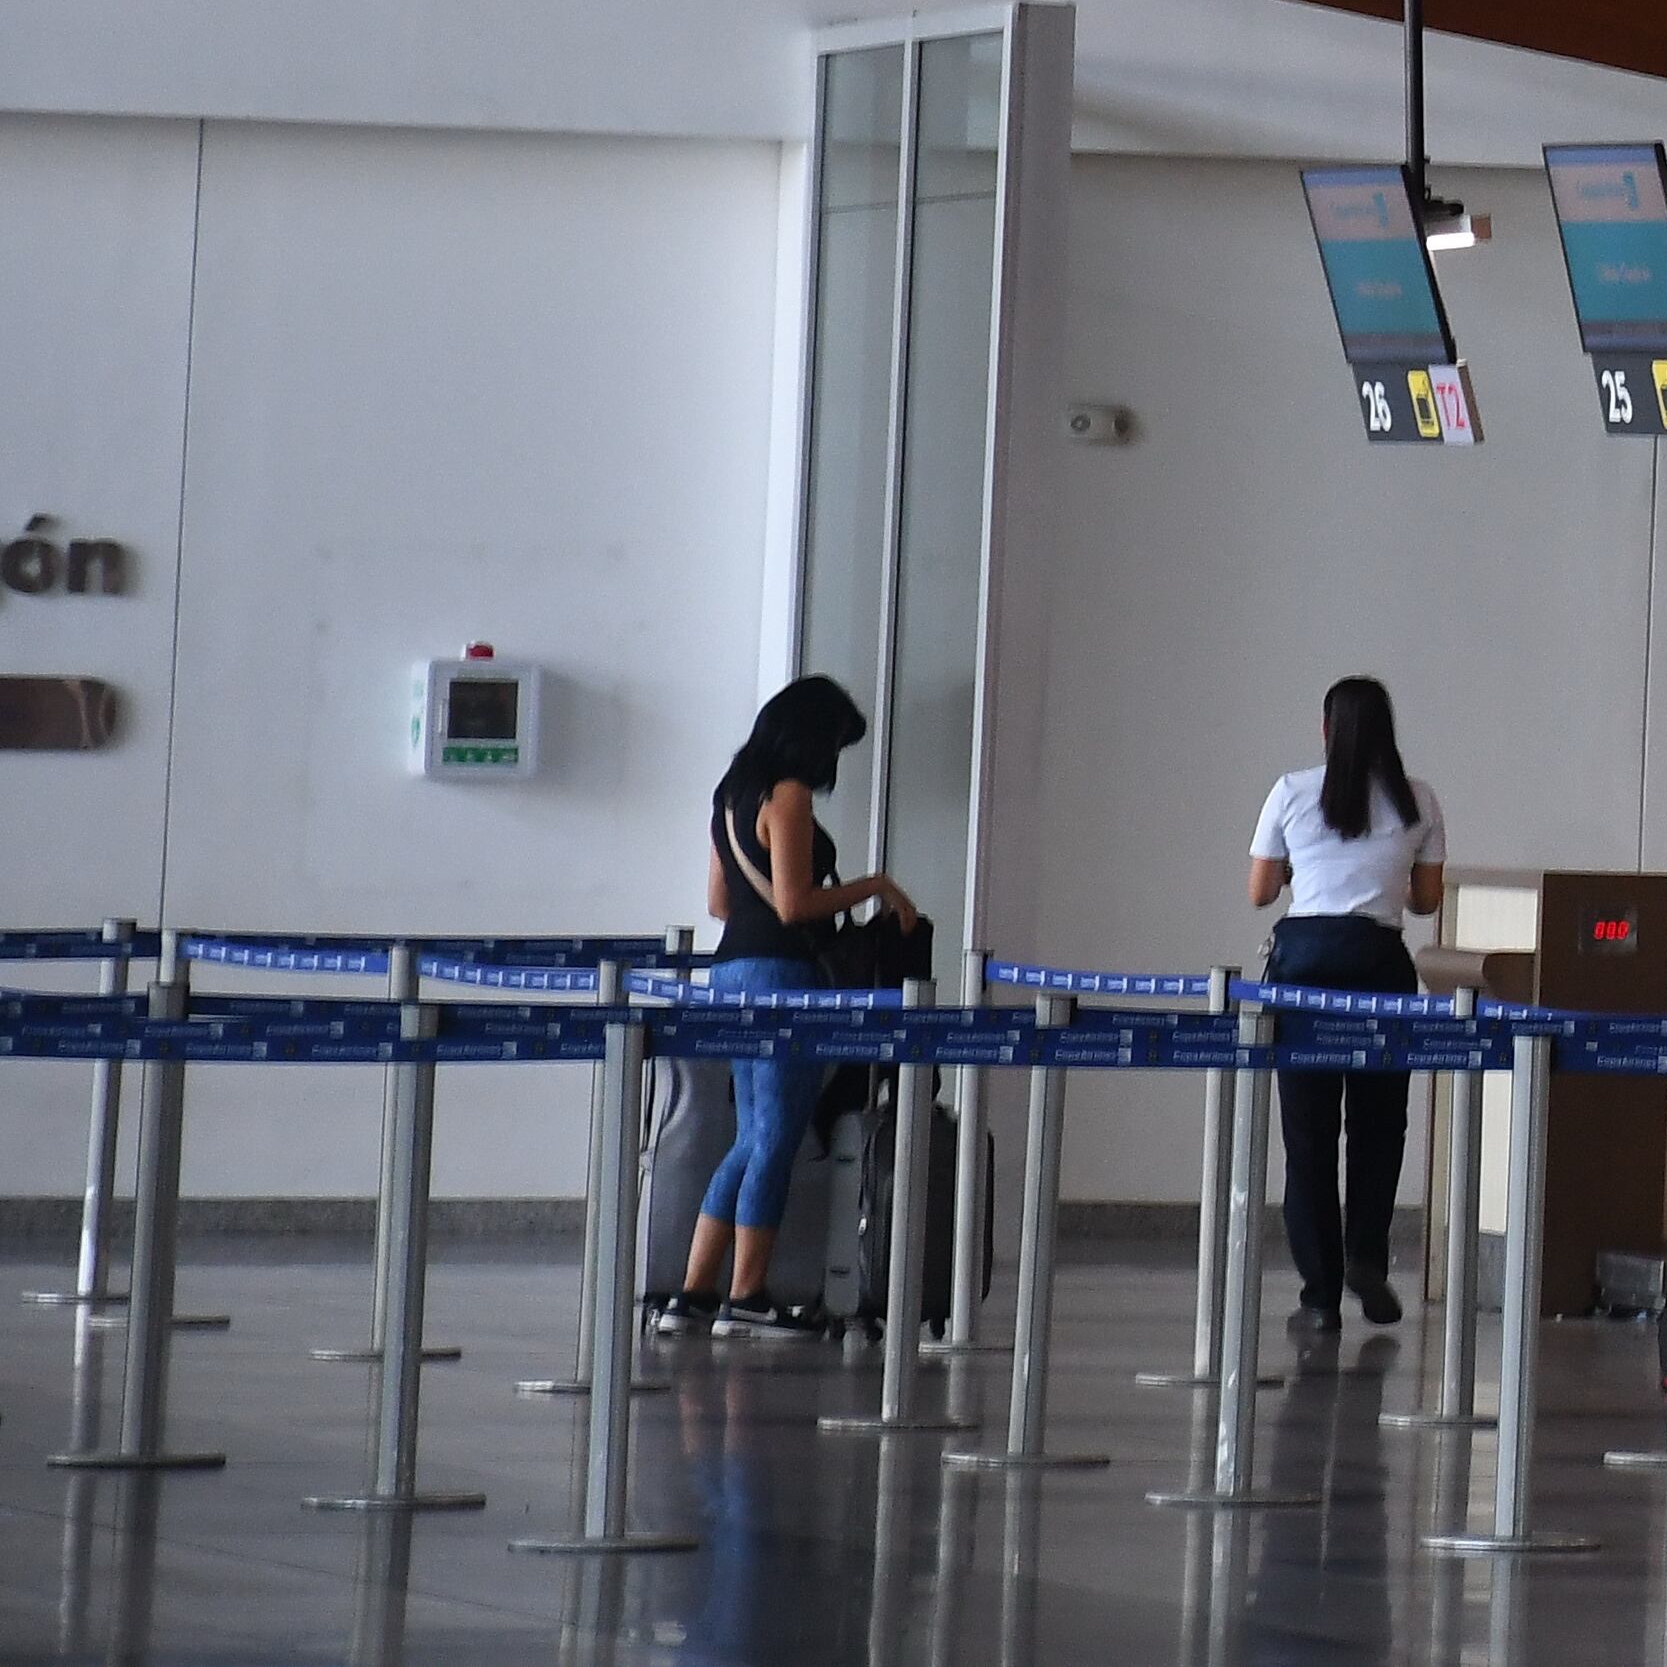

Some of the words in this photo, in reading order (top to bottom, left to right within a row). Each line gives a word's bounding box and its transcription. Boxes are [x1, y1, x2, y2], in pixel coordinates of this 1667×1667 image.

[1361, 380, 1393, 433] 26
[1436, 381, 1465, 428] T2
[1600, 370, 1634, 424] 25
[0, 512, 124, 596] ón
[1594, 920, 1630, 940] 000
